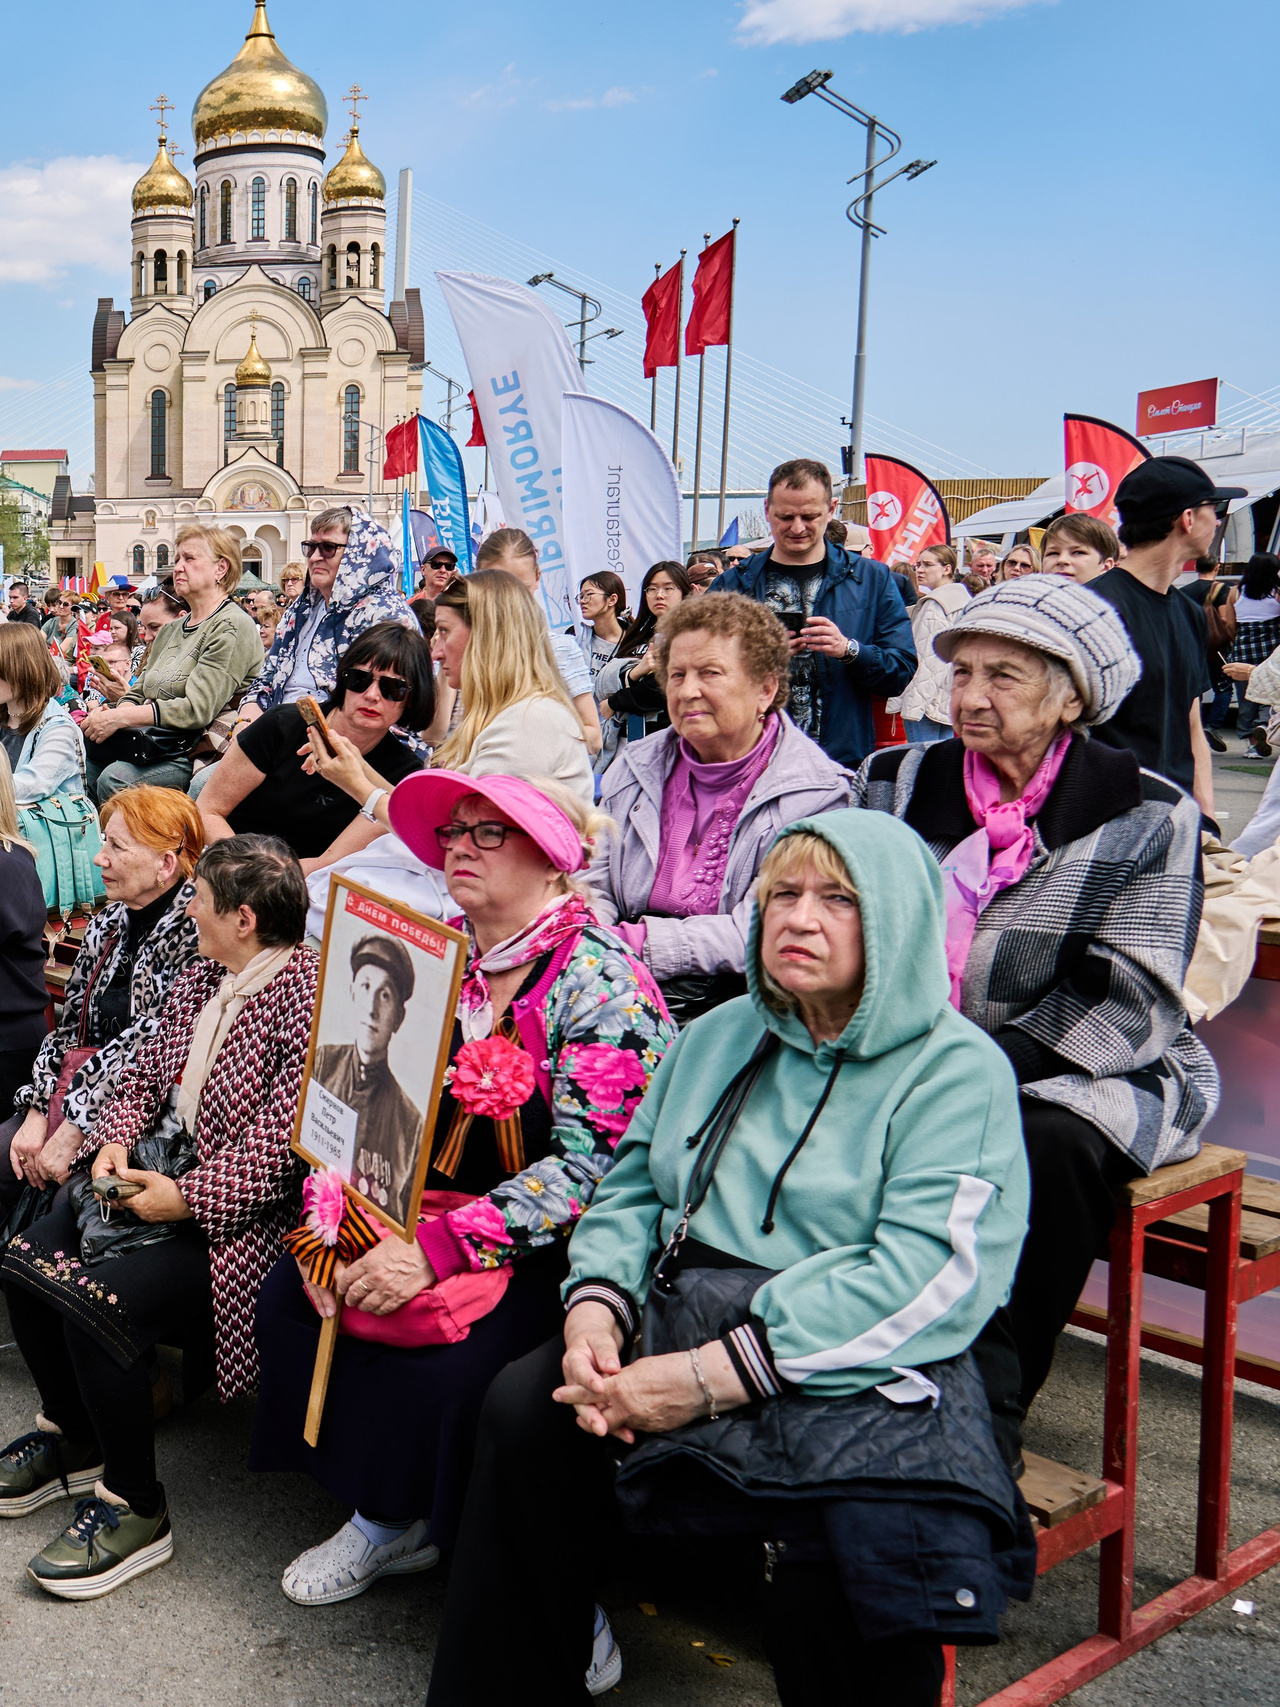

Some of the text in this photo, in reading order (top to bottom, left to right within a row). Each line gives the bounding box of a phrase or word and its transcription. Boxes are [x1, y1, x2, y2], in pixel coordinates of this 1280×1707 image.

[357, 904, 388, 923] ДНЕМ
[391, 918, 445, 951] ПОБЕДЫ!
[319, 1089, 344, 1115] Смирнов
[321, 1107, 337, 1125] Петр
[310, 1112, 345, 1146] Васильевич
